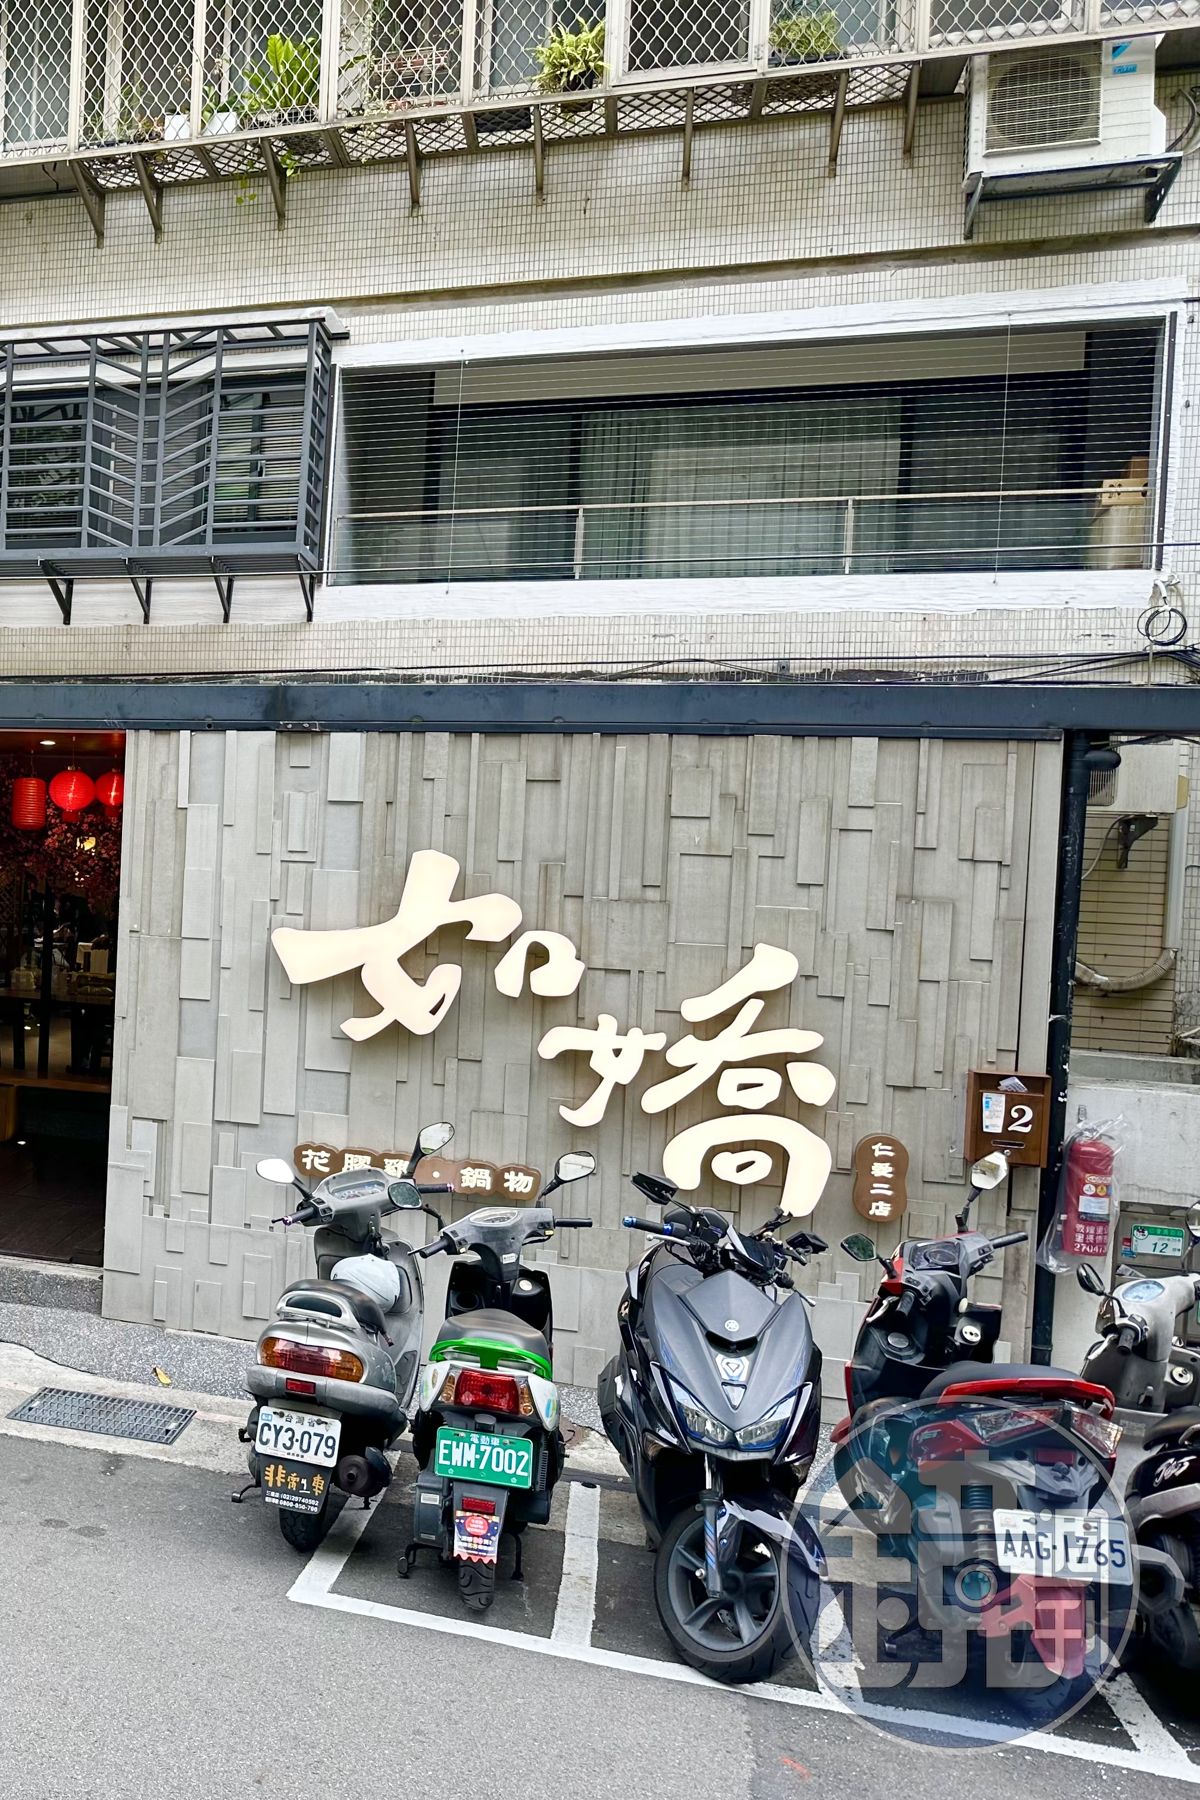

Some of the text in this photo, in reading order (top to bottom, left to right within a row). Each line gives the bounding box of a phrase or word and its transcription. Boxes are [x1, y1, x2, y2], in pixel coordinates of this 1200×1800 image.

[270, 848, 837, 1218] 如嬌
[1007, 1104, 1033, 1133] 2
[868, 1142, 896, 1218] 仁愛二店
[1152, 1242, 1169, 1253] 12
[438, 1439, 529, 1477] EWM-7002
[469, 1433, 500, 1446] 電動車
[1003, 1529, 1127, 1569] AAG-1765
